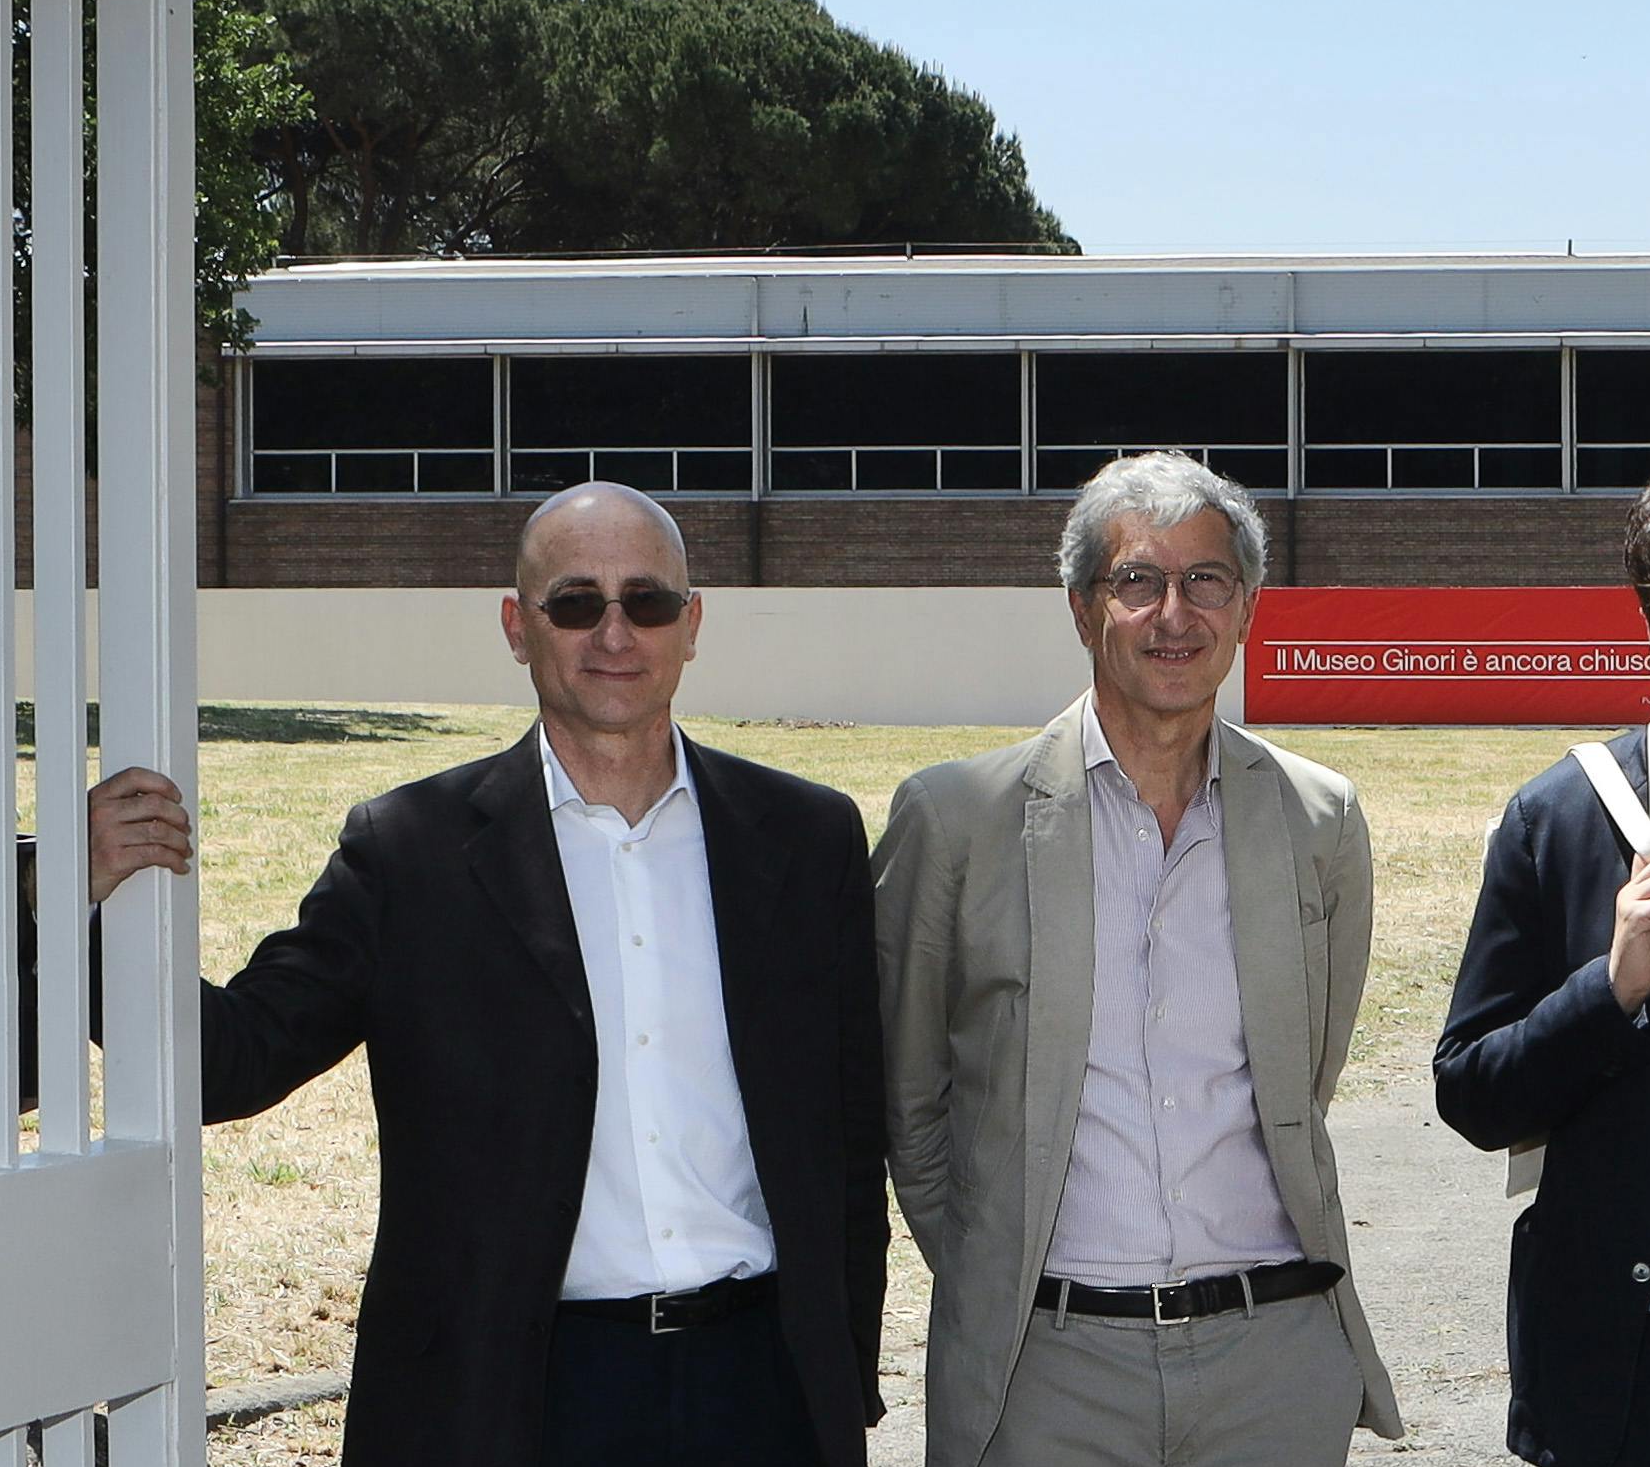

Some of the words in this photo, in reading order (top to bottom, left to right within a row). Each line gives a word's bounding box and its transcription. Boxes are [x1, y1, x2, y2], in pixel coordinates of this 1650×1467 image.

[1276, 648, 1286, 670] Il
[1293, 648, 1375, 671] Museo
[1382, 648, 1455, 671] Ginori
[1463, 648, 1478, 671] è
[1485, 653, 1572, 671] ancora
